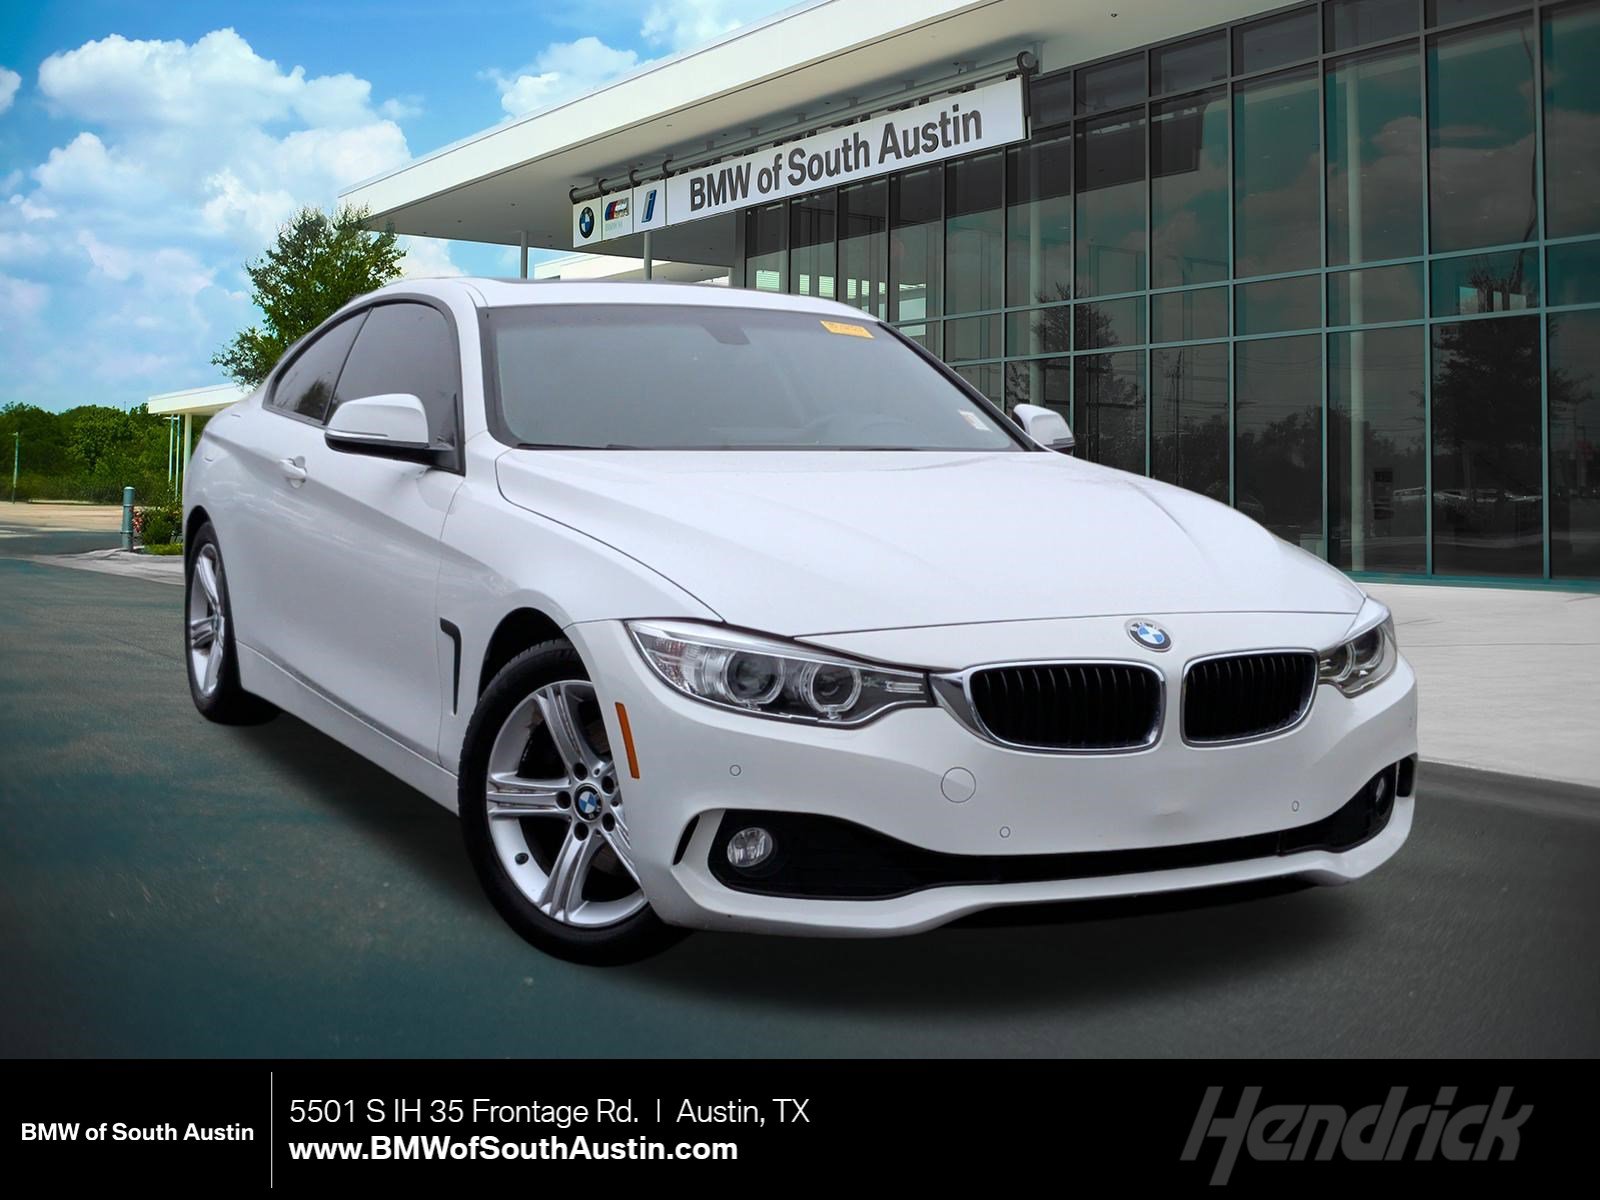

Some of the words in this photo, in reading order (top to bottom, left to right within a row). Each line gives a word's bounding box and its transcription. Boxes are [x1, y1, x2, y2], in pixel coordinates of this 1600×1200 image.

[690, 162, 751, 211] BMW
[757, 153, 783, 194] of
[787, 131, 870, 187] South
[878, 103, 982, 164] Austin
